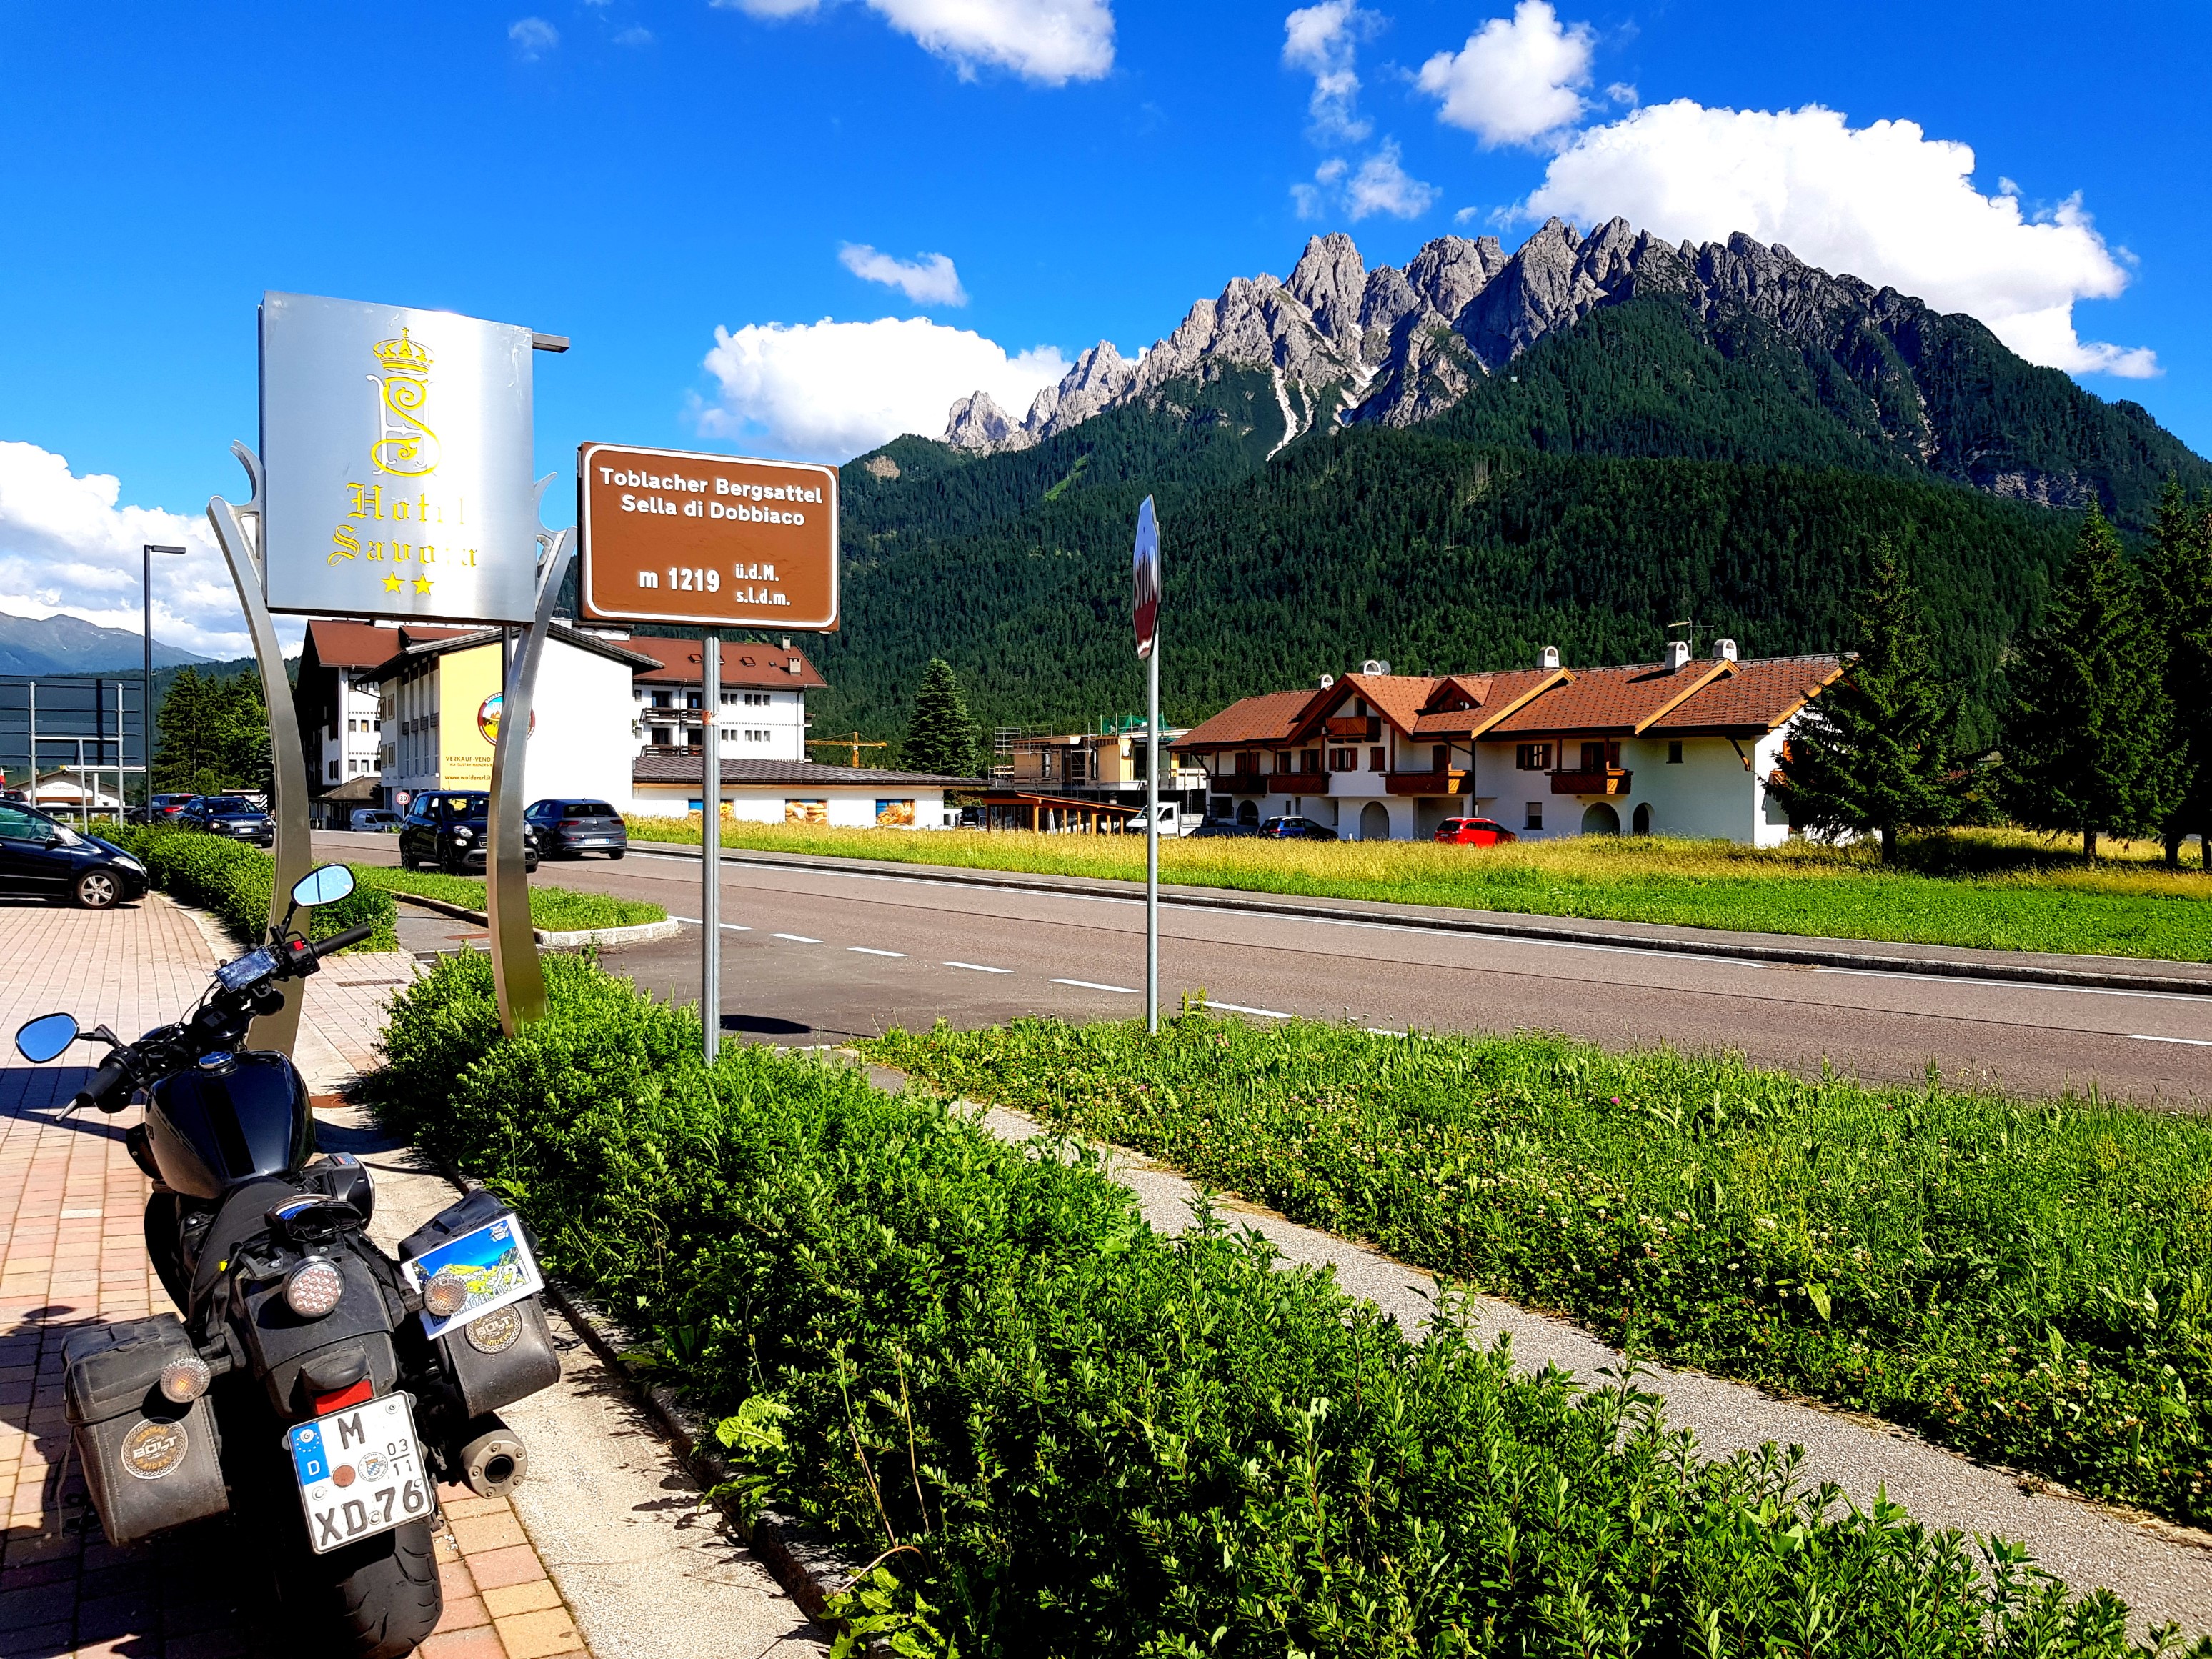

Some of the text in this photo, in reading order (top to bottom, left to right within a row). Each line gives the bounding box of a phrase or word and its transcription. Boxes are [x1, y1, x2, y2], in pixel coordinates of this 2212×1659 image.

[599, 467, 822, 503] Toblacher Bergsattel
[621, 494, 805, 526] Sella di Dobbiaco
[327, 524, 477, 567] Savoa
[639, 567, 720, 592] m 1219
[735, 563, 779, 582] ü.d.M.
[1135, 545, 1157, 611] STOP
[736, 587, 791, 606] s.l.d.m.
[487, 1331, 512, 1345] RIDERS
[337, 1412, 366, 1450] M
[133, 1435, 178, 1459] BOLT
[387, 1438, 409, 1456] 03
[307, 1460, 321, 1476] D
[393, 1459, 412, 1477] 11
[375, 1479, 424, 1523] 76
